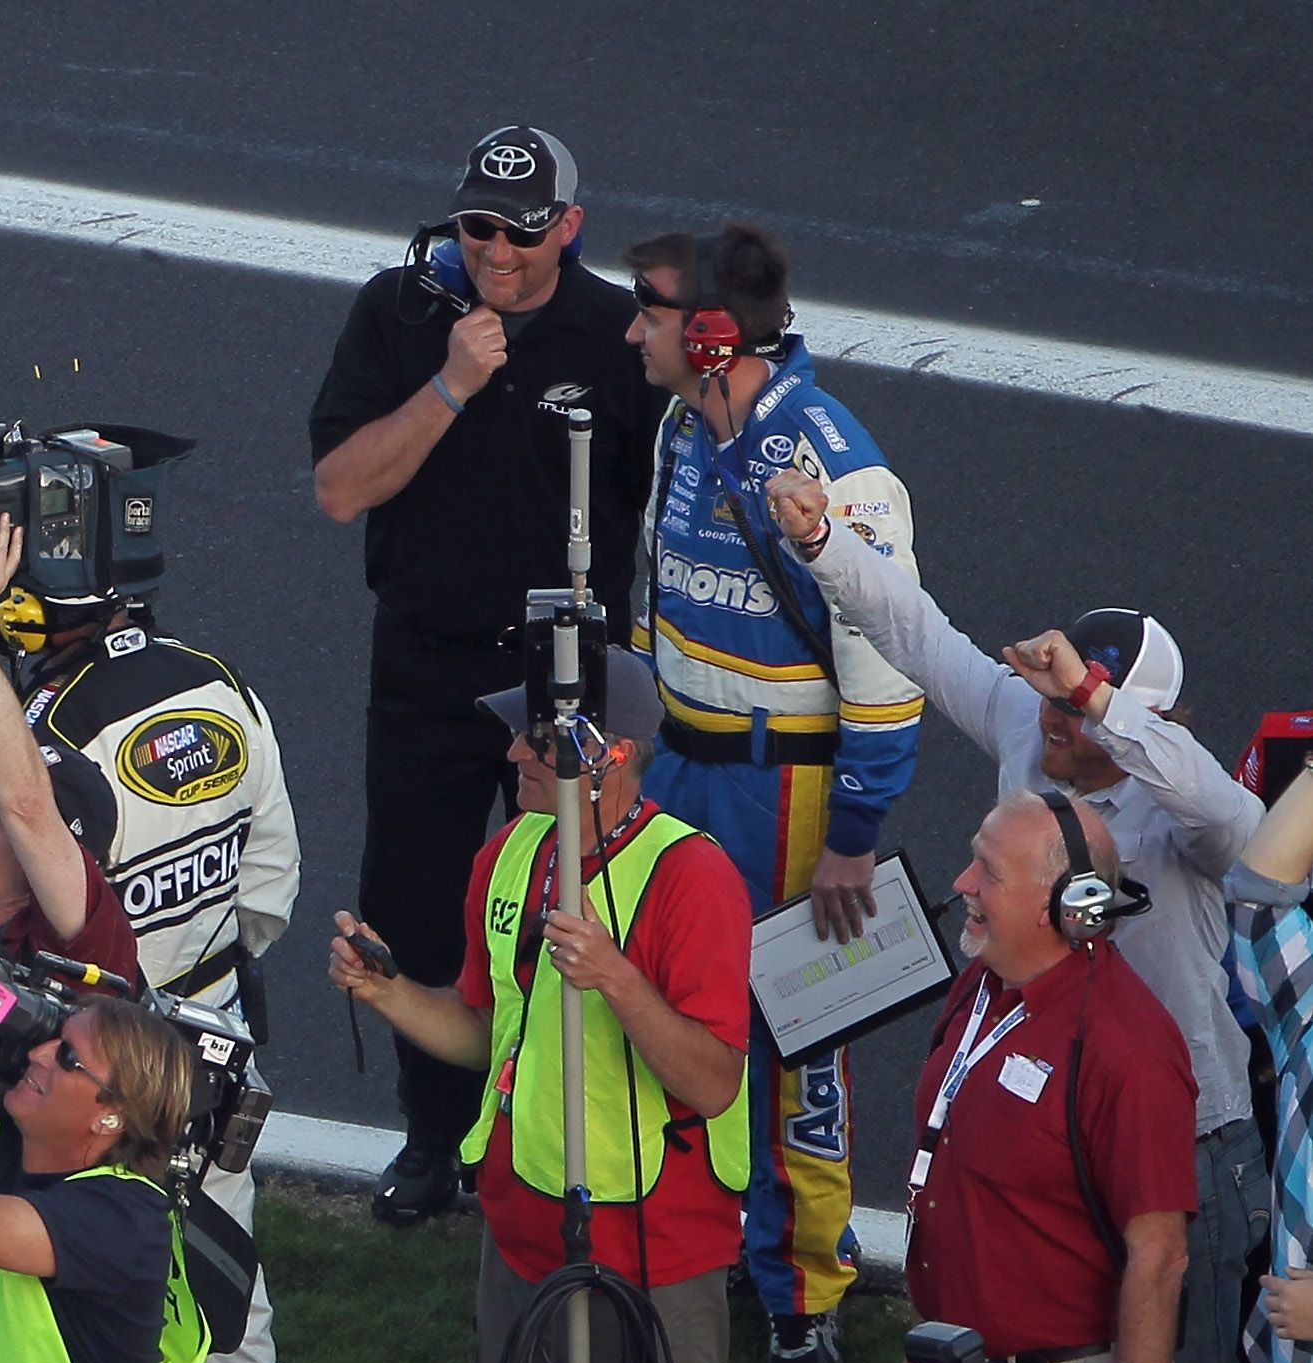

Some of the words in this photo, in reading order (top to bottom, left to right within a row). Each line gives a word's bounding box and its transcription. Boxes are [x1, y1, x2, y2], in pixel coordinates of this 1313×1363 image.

[155, 722, 198, 758] NASCAR
[166, 743, 213, 781] Sprint
[179, 780, 204, 801] CUP
[204, 769, 241, 791] SERIES
[124, 835, 239, 915] OFFICIA
[209, 1039, 231, 1053] bsi
